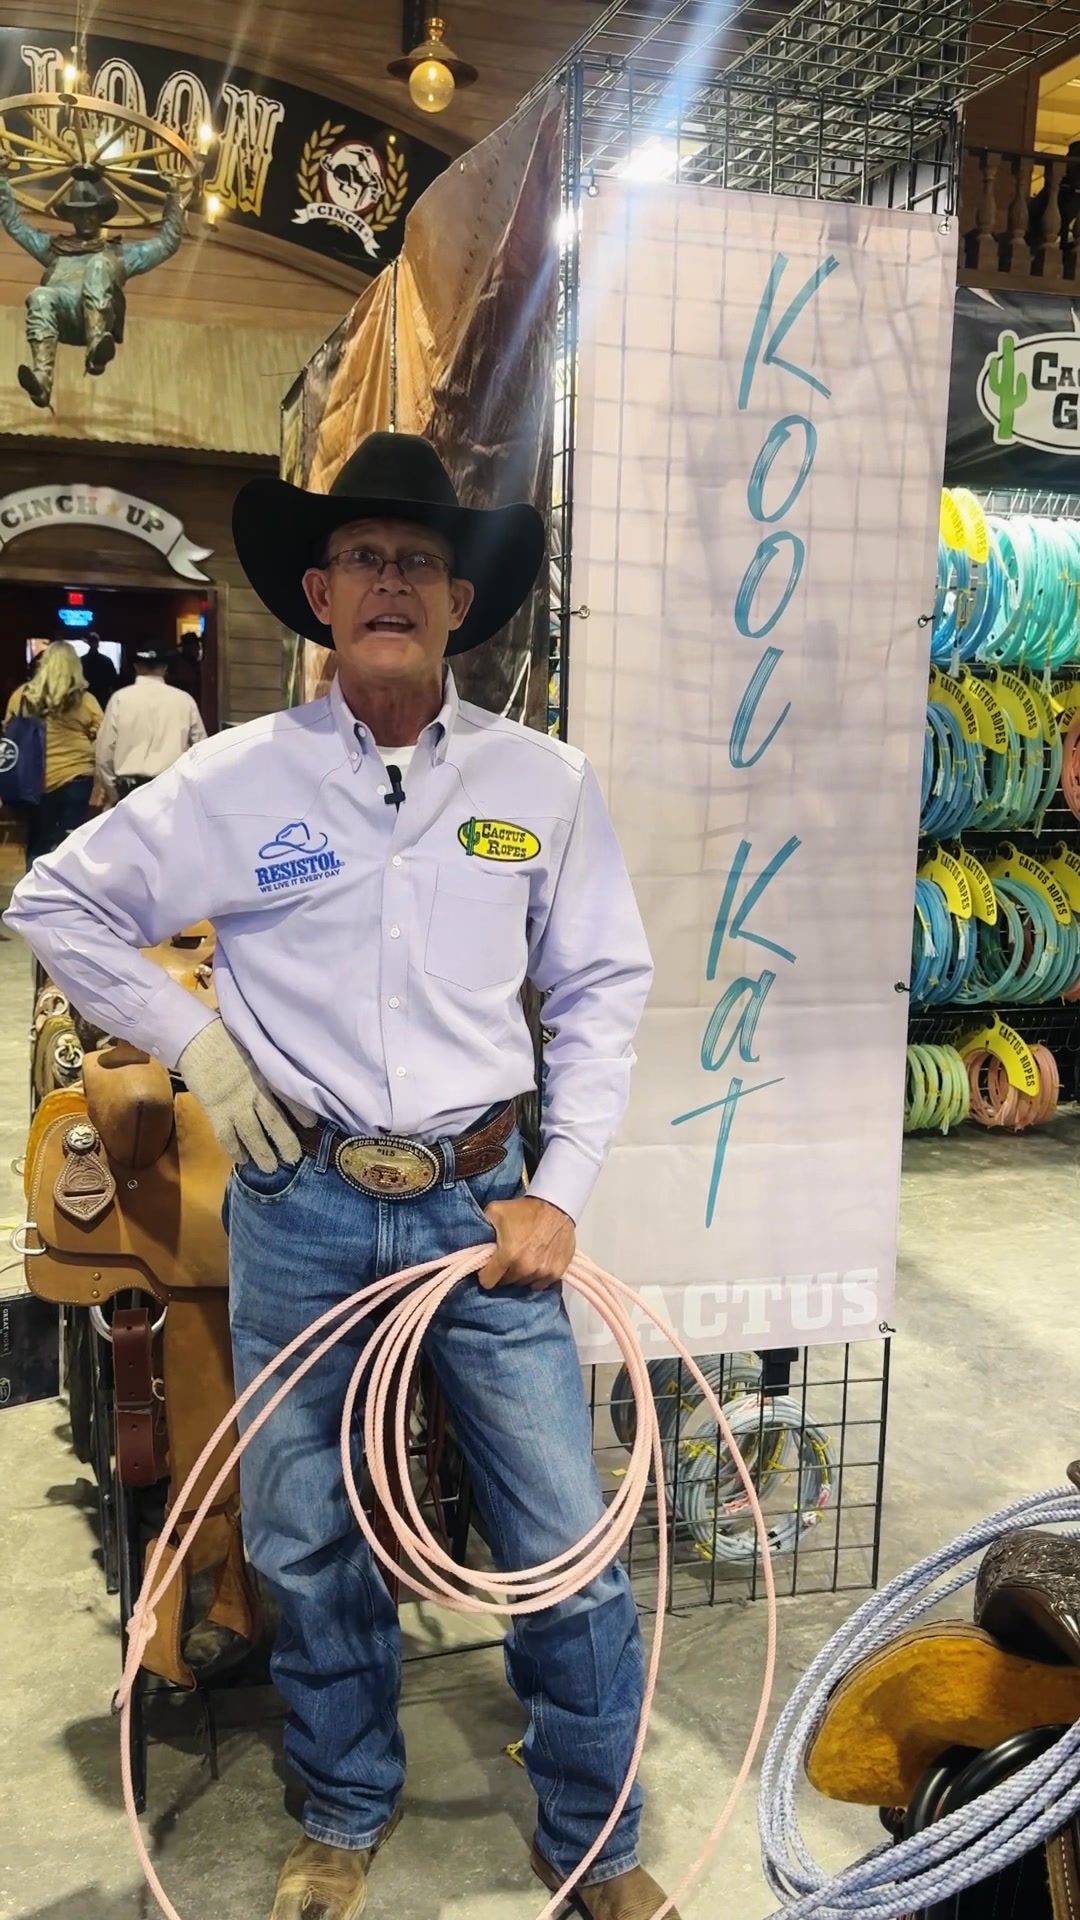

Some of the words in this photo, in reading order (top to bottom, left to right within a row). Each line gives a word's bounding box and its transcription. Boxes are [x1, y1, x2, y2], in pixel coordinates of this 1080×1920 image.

[0, 44, 286, 217] LOON
[317, 205, 366, 232] CINCH
[1032, 351, 1080, 391] CA
[0, 495, 98, 529] CINCH
[126, 504, 165, 534] UP
[940, 676, 965, 705] CACTUS
[961, 700, 978, 735] ROPES
[968, 679, 998, 713] CACTUS
[990, 710, 1007, 745] ROPES
[1001, 674, 1027, 701] CACTUS
[1022, 697, 1038, 731] ROPES
[481, 823, 527, 843] CACTUS
[486, 839, 527, 858] ROPES
[255, 850, 341, 887] RESISTOL
[273, 880, 290, 891] LIVE
[291, 878, 299, 886] IT
[300, 873, 324, 884] EVERY
[324, 868, 341, 879] DAY
[940, 853, 961, 882] CACTUS
[957, 877, 970, 910] ROPES
[963, 855, 986, 885] CACTUS
[981, 883, 995, 917] ROPES
[1018, 855, 1051, 885] CACTUS
[1047, 883, 1068, 916] ROPES
[1064, 853, 1080, 877] CACT
[999, 1025, 1025, 1056] CACTUS
[1019, 1054, 1036, 1087] ROPES
